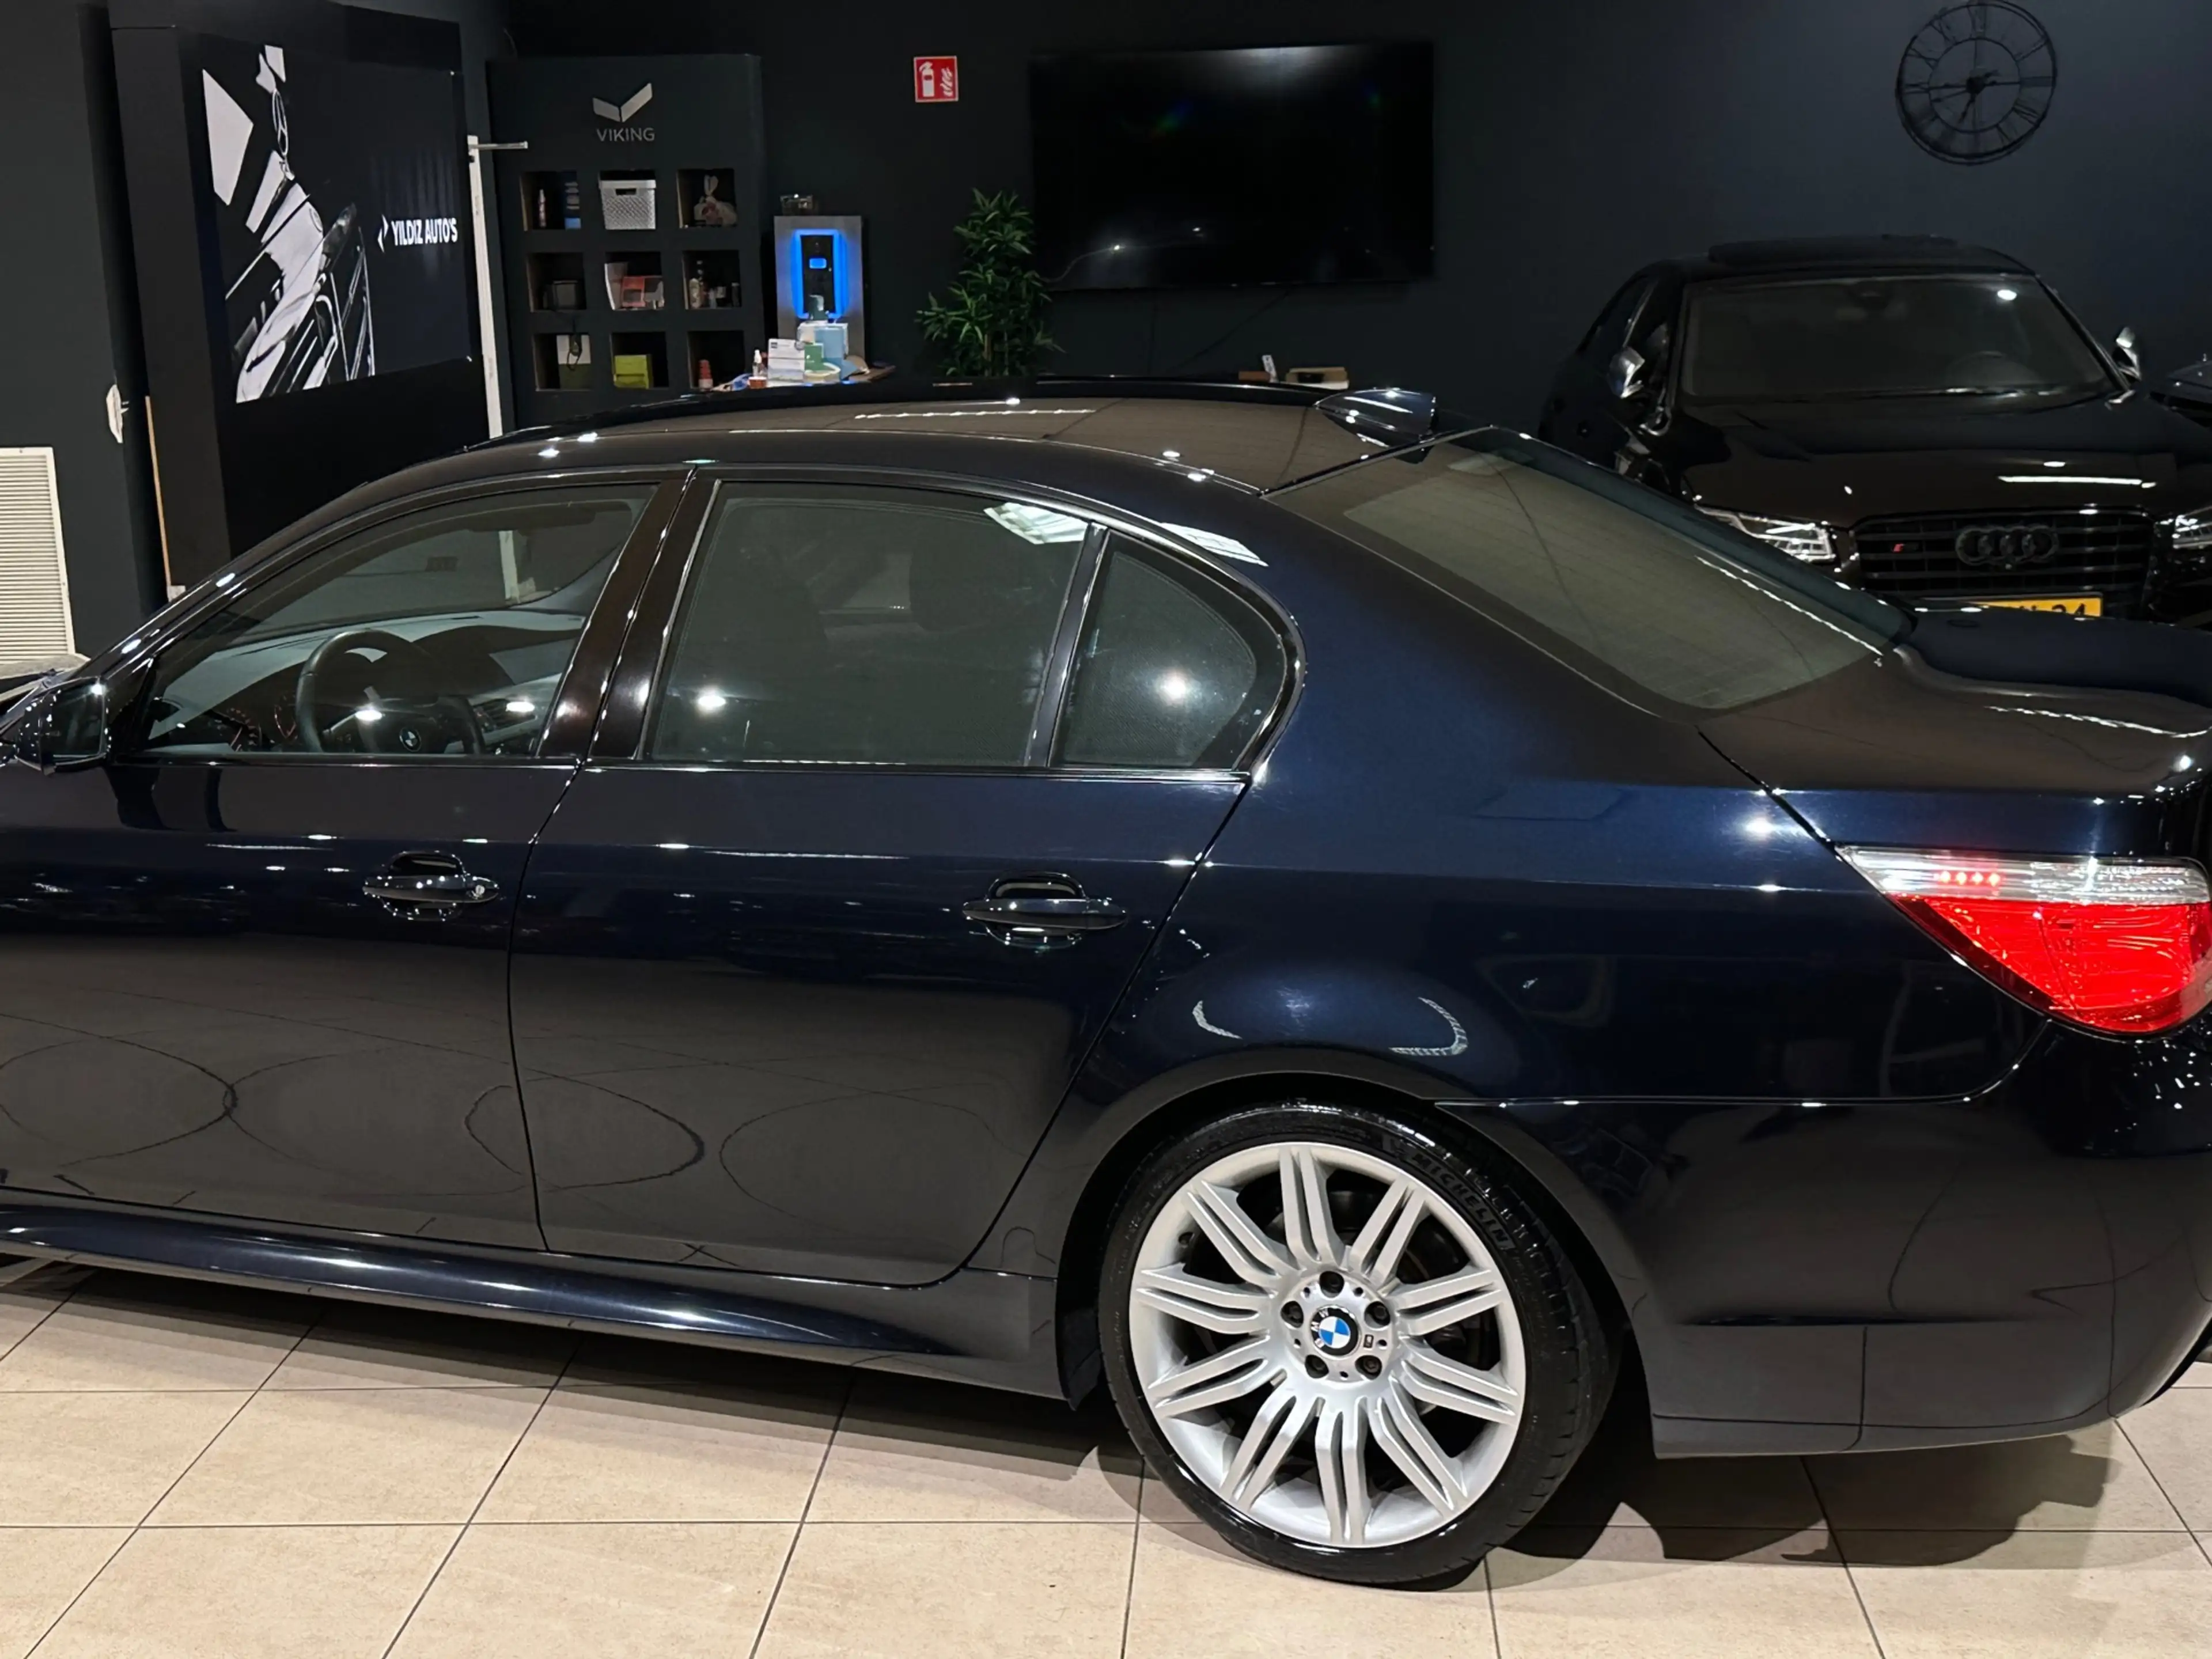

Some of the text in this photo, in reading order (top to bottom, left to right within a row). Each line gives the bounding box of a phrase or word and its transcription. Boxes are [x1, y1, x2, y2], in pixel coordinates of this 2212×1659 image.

[596, 127, 656, 142] VIKING
[391, 217, 459, 247] YILDIZ AUTO'S
[1412, 1153, 1509, 1242] MICHELIN
[1310, 1308, 1330, 1349] BMW
